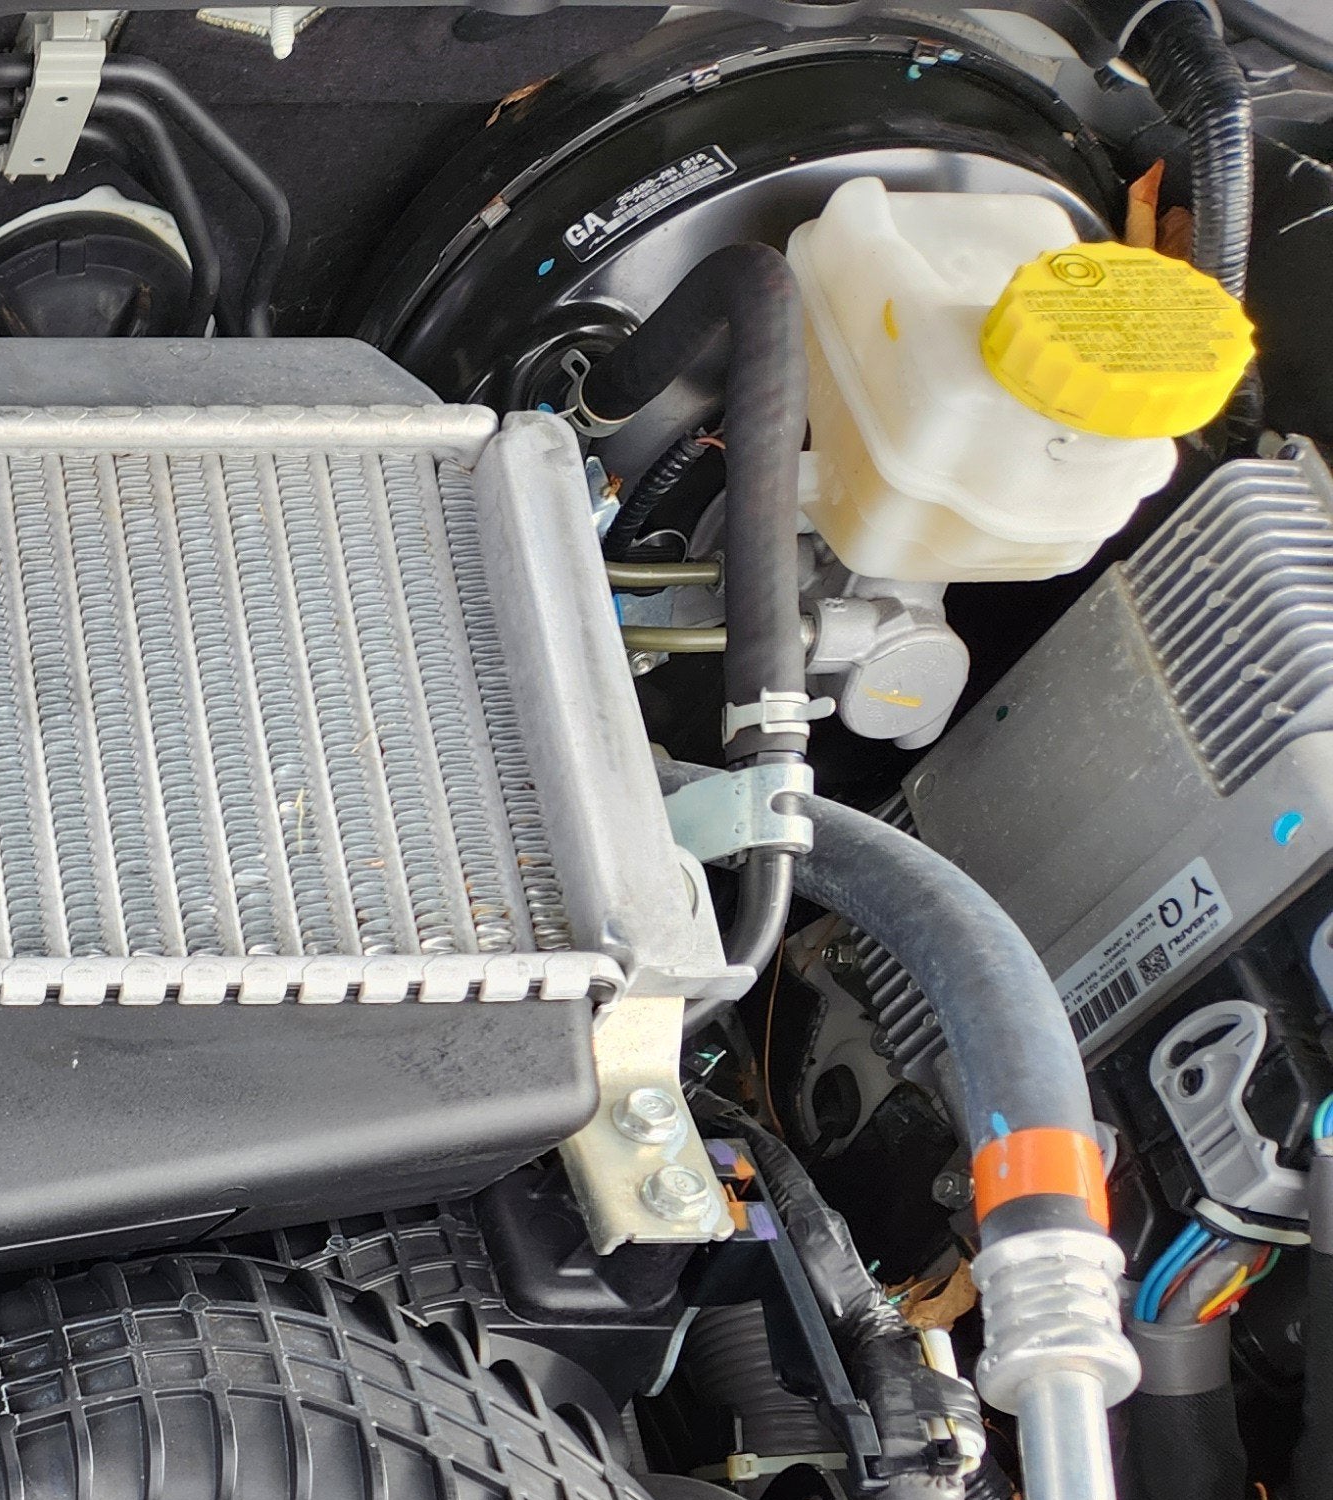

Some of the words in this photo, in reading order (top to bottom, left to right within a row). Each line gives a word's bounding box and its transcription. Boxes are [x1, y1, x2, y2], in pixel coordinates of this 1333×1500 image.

[565, 212, 607, 246] GA
[1167, 903, 1220, 950] SUBARU
[1103, 937, 1123, 957] JAPAN
